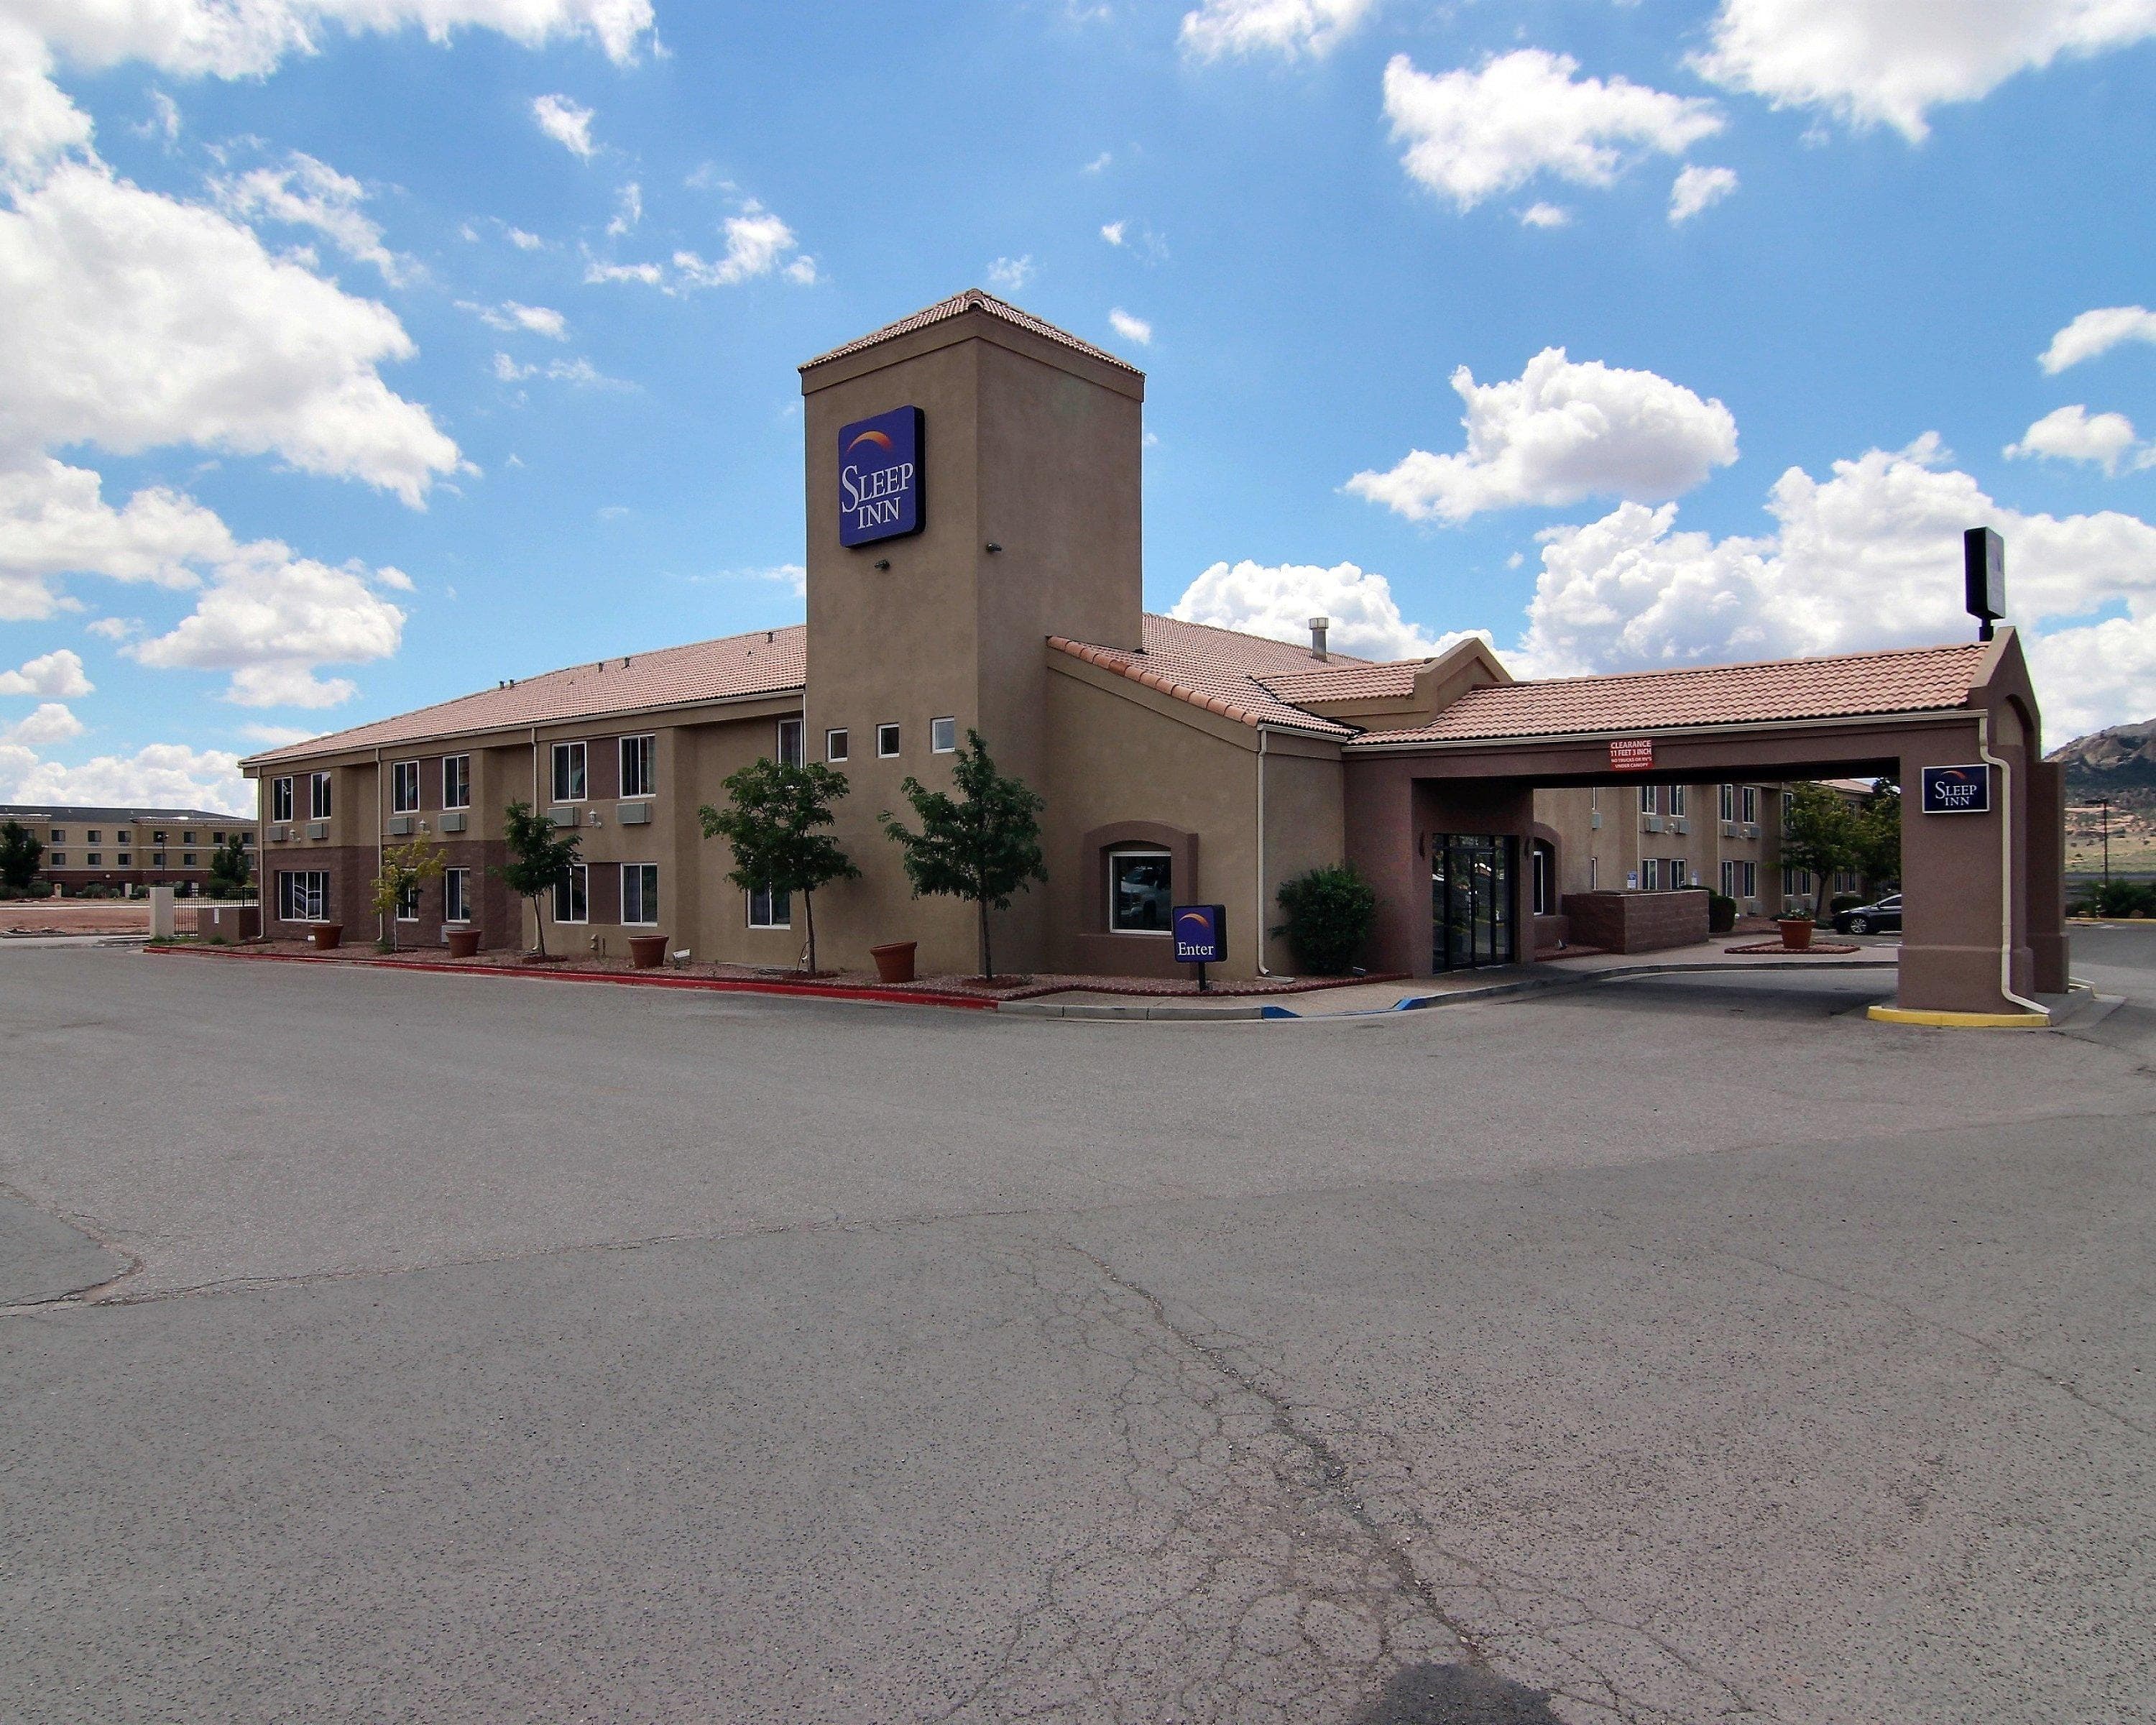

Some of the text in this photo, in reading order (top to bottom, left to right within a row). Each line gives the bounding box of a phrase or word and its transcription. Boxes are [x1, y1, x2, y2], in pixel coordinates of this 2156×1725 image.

[842, 463, 913, 513] SLEEP
[857, 497, 900, 530] INN
[1611, 740, 1651, 749] CLEARANCE
[1935, 781, 1977, 799] SLEEP
[1945, 796, 1970, 806] INN
[1177, 942, 1214, 955] Enter
